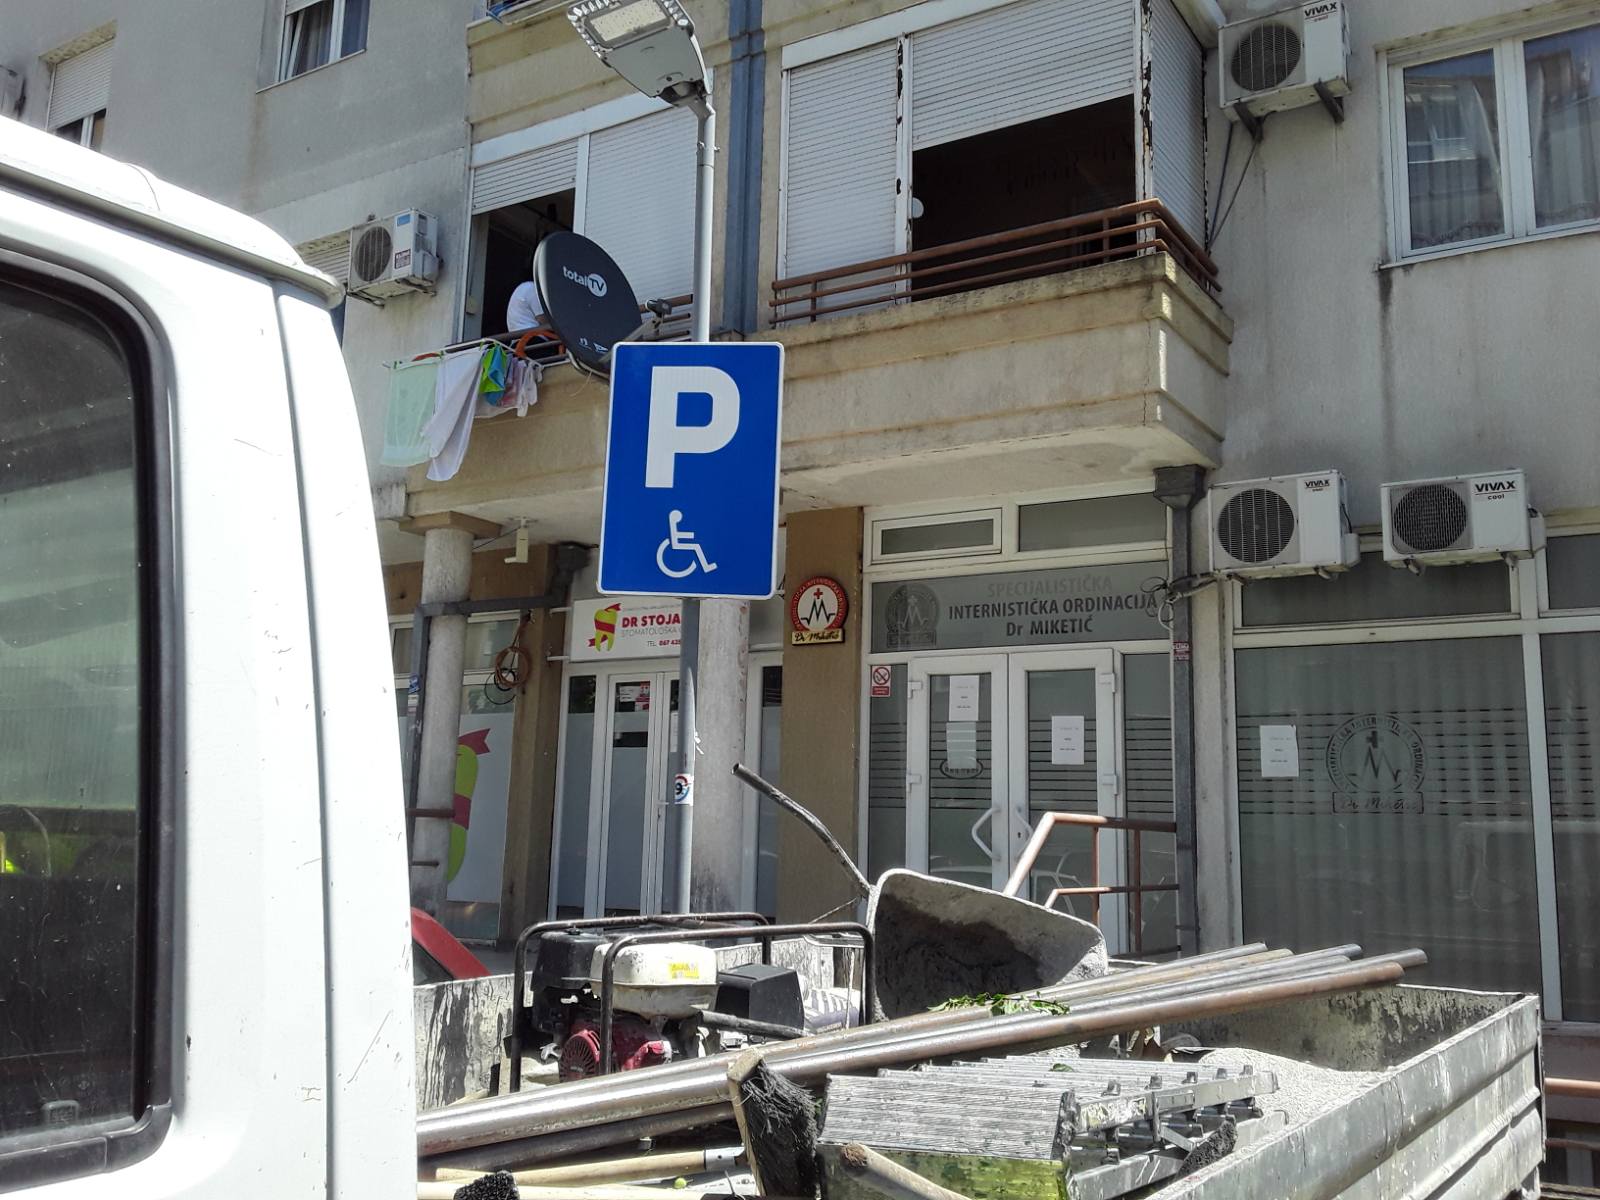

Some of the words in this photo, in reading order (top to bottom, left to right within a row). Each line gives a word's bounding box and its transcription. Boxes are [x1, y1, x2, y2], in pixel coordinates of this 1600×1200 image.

[1304, 2, 1337, 16] VIVAX
[645, 366, 740, 488] P
[1304, 479, 1330, 488] VIVAX
[1474, 480, 1516, 493] VIVAX
[1063, 593, 1158, 614] ORDINACIJA
[622, 616, 638, 628] DR
[1006, 622, 1023, 637] Dr
[1030, 614, 1094, 635] MIKETIĆ
